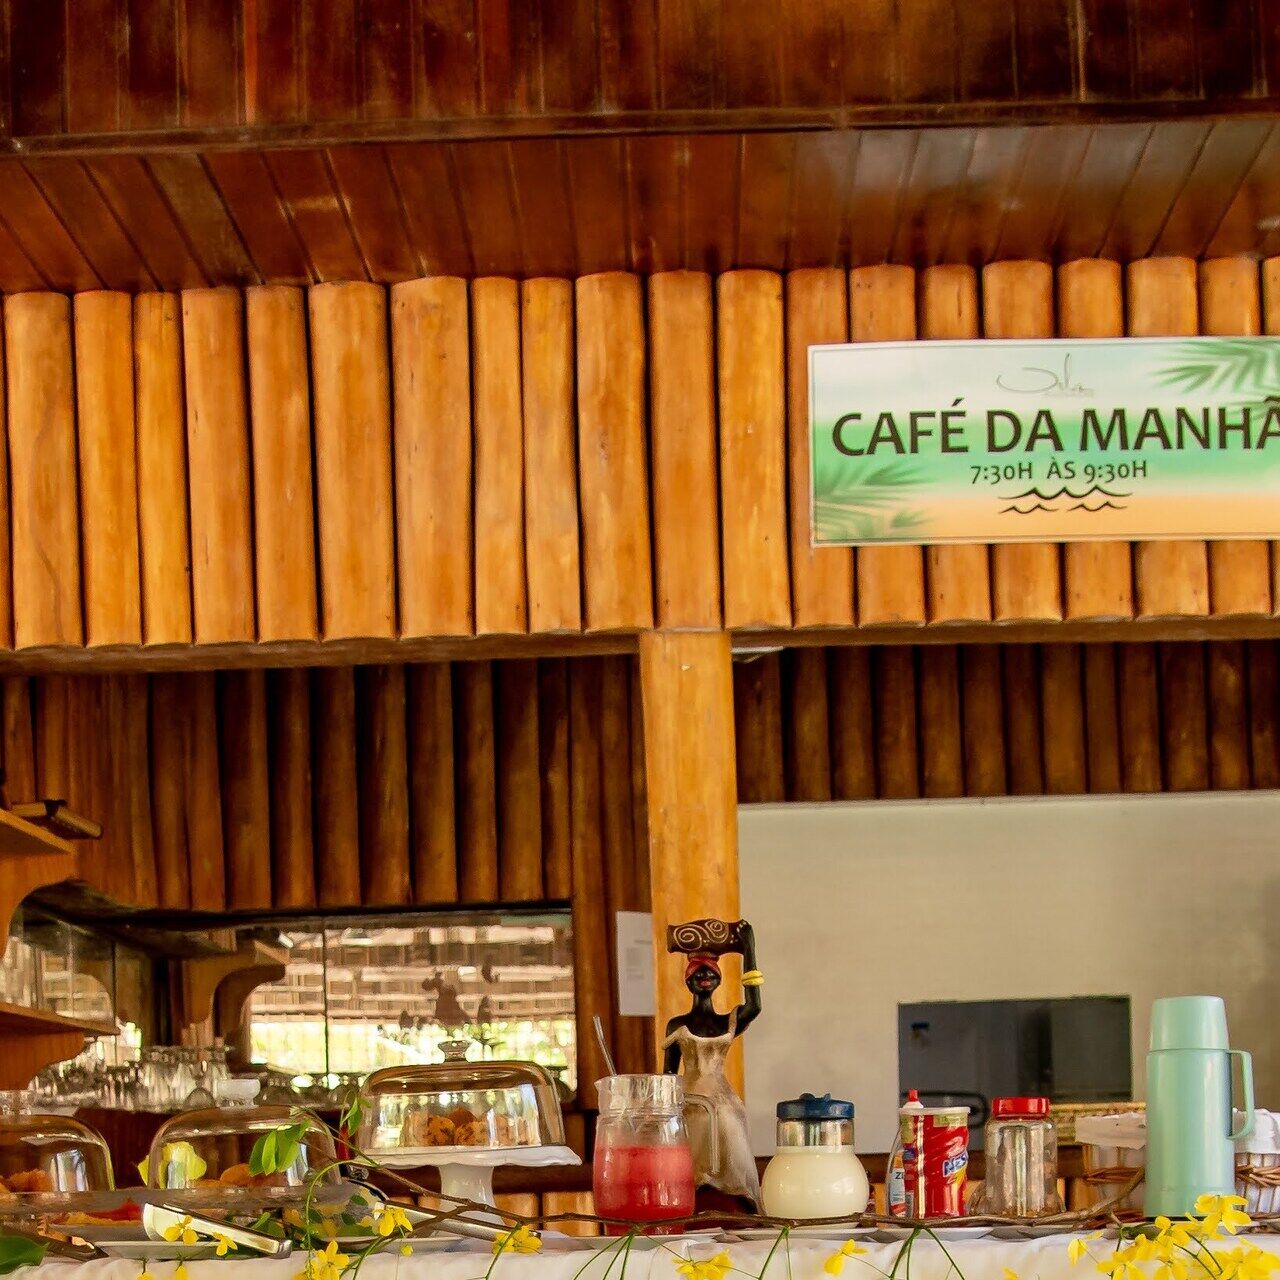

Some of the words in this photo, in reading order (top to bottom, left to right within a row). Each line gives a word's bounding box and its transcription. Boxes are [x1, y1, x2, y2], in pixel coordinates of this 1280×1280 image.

[833, 399, 968, 456] CAFÉ
[988, 411, 1064, 452] DA
[971, 462, 1032, 484] 7:30H
[1047, 457, 1075, 479] ÀS
[1084, 461, 1146, 483] 9:30H
